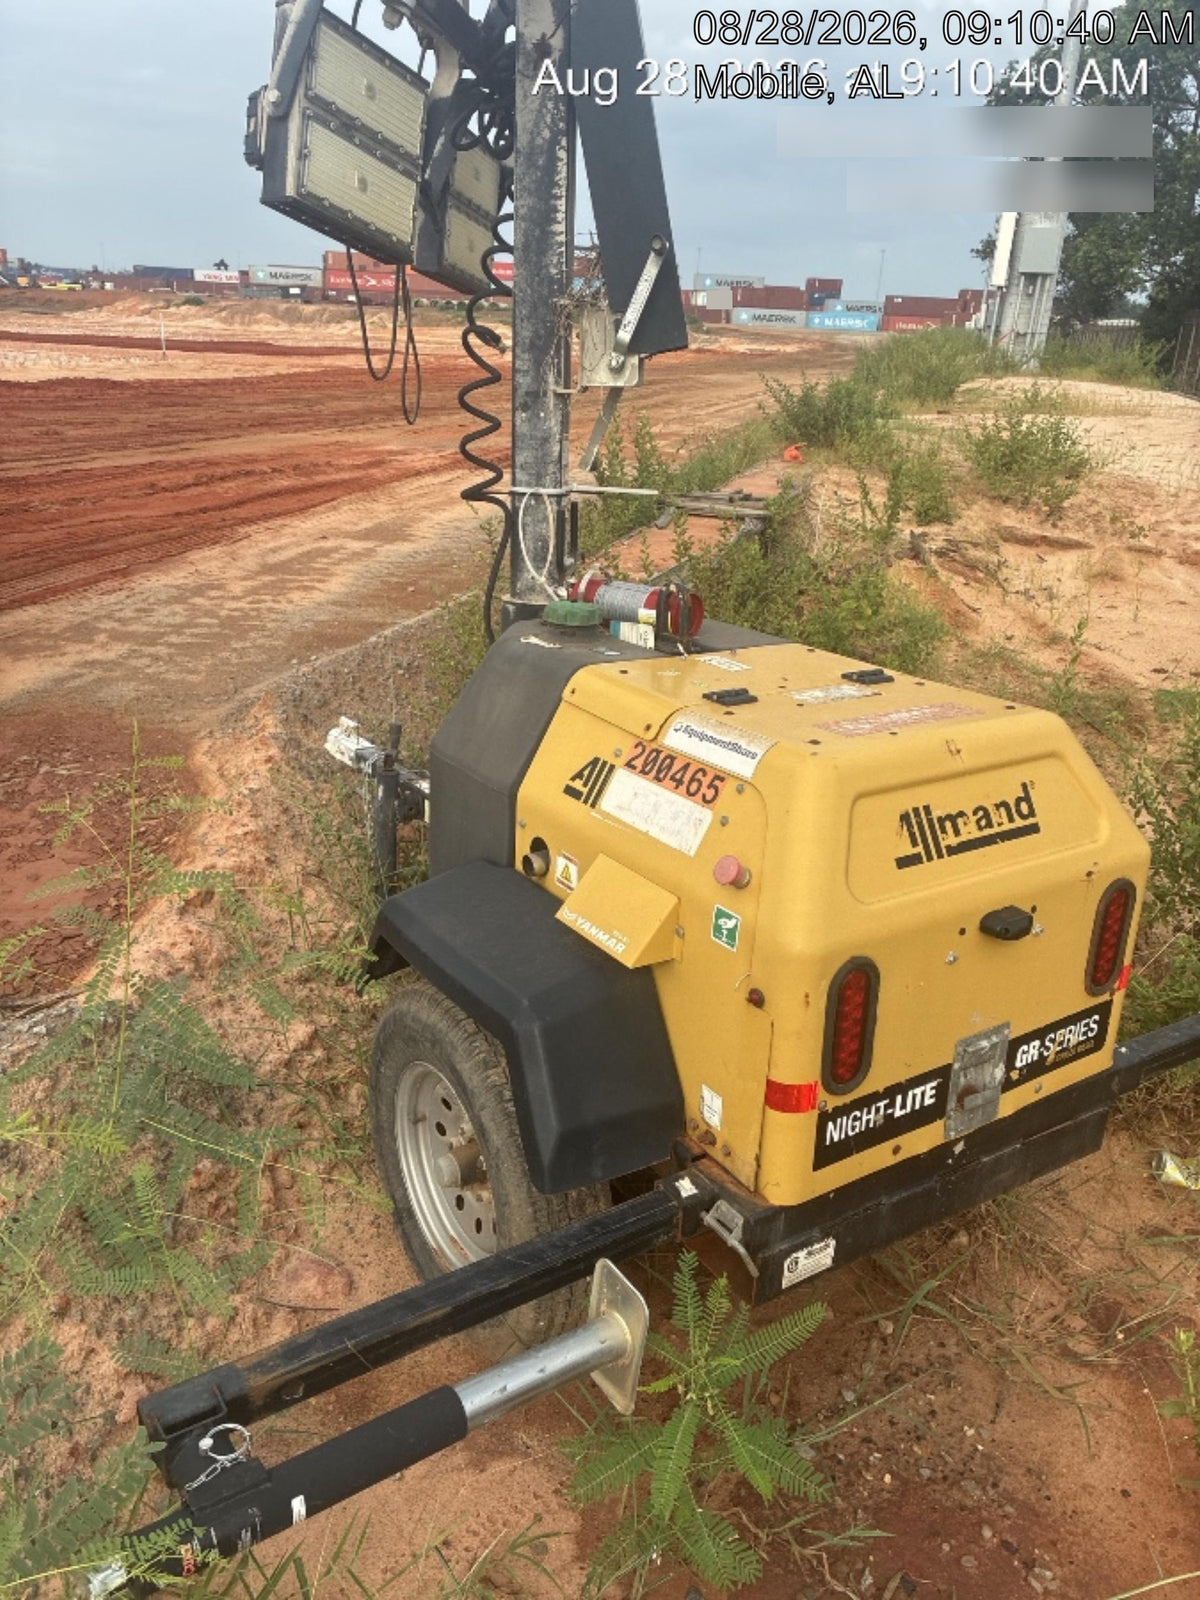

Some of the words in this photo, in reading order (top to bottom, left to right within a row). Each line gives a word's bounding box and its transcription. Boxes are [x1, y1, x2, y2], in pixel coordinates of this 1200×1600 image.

[752, 313, 797, 324] MAERSK
[624, 741, 726, 804] 200465
[895, 781, 1040, 869] Allmand
[575, 915, 627, 955] YANMAR
[1014, 1014, 1100, 1069] GR-SERIES
[825, 1080, 939, 1146] NIGHT-LITE
